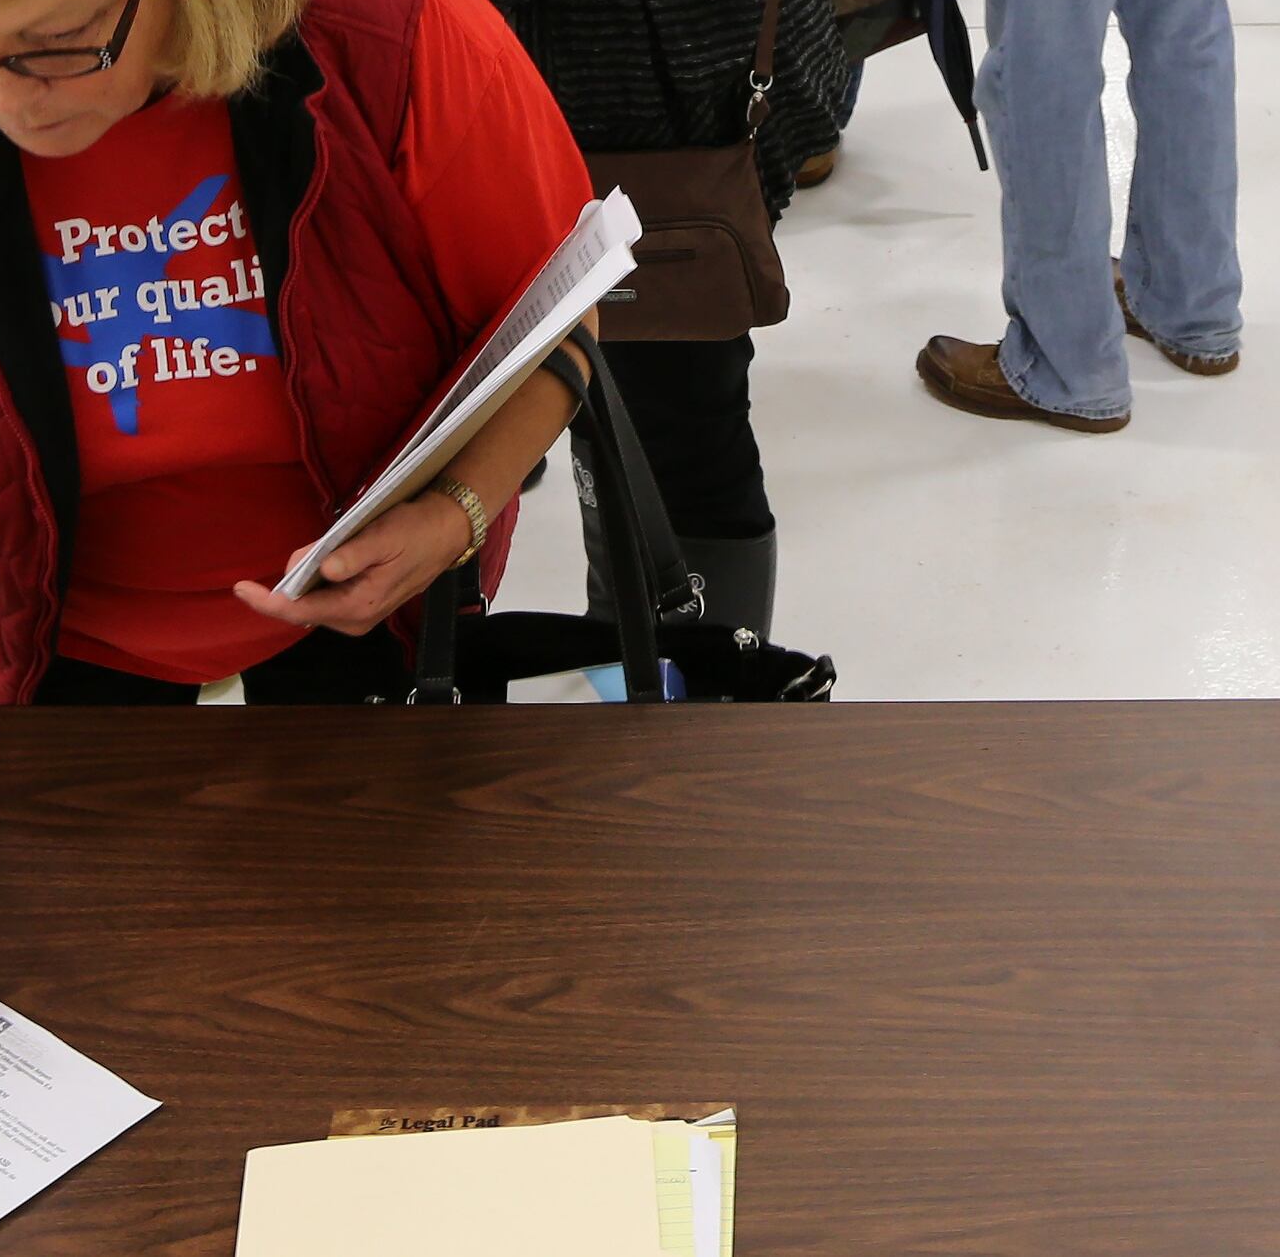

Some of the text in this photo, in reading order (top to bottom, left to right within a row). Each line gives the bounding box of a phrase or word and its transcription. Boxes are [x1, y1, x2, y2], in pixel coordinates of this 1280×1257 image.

[54, 200, 248, 265] Protect
[136, 254, 266, 324] quali
[86, 336, 257, 394] of life.
[401, 1115, 455, 1133] Legal
[462, 1114, 501, 1130] Pad
